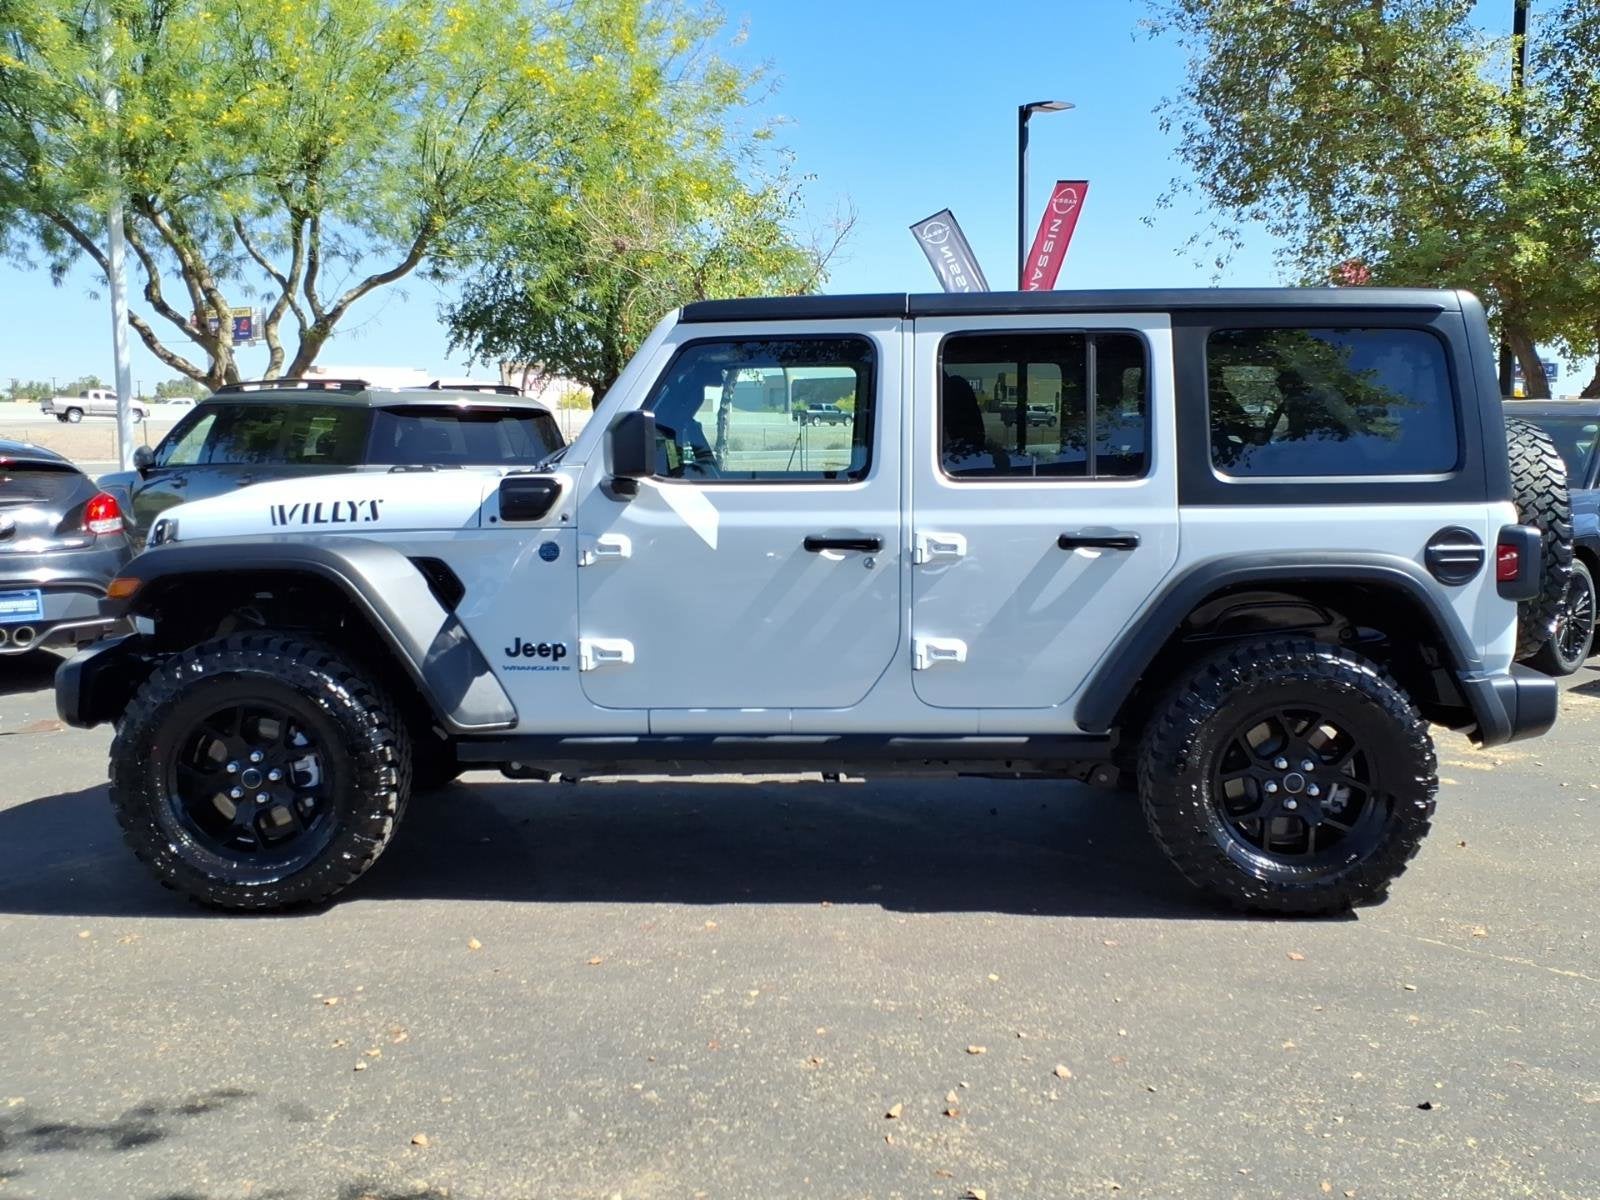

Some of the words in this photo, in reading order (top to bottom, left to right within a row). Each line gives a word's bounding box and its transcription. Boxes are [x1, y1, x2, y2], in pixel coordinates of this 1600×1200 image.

[1029, 219, 1062, 291] NISSAN
[270, 499, 384, 526] WILLYS
[504, 637, 567, 662] Jeep
